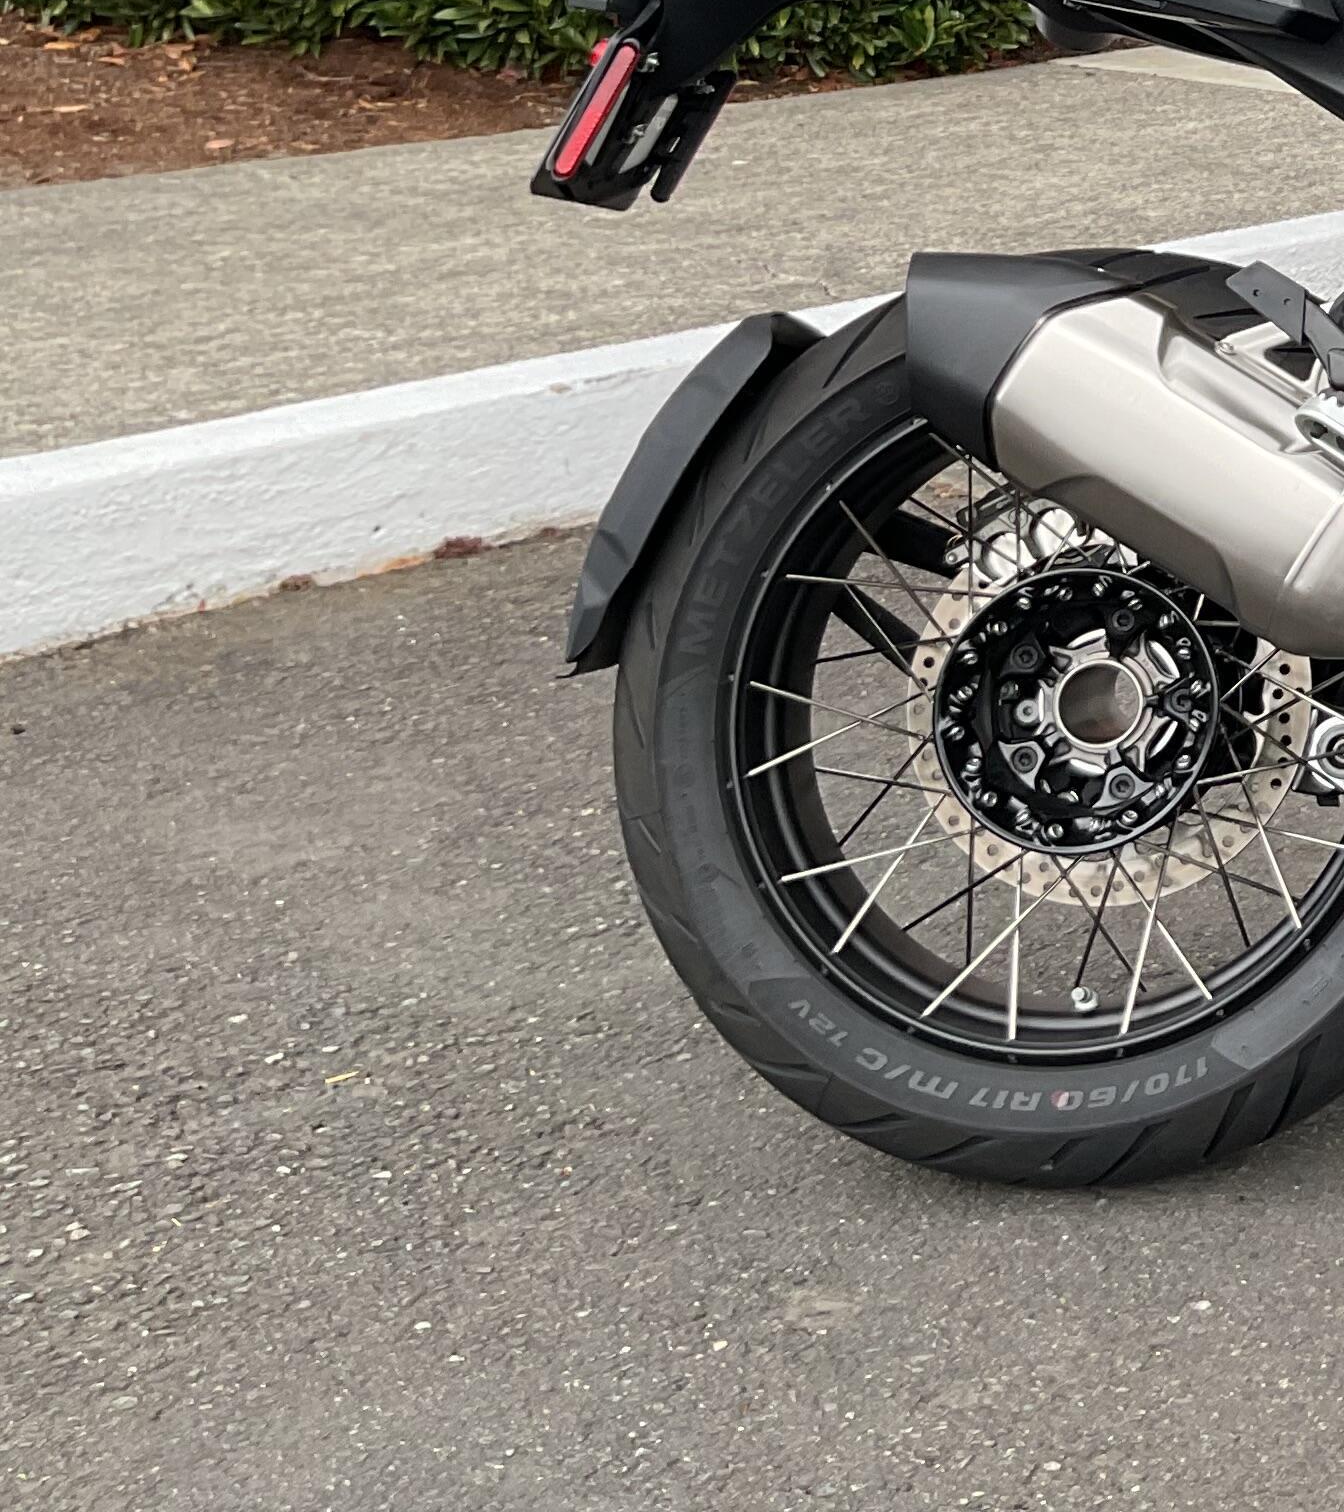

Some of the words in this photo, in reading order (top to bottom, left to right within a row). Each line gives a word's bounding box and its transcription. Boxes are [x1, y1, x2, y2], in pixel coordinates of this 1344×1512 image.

[678, 395, 869, 656] METZELER
[787, 998, 850, 1049] 72V
[967, 1086, 1042, 1113] R17
[1054, 1055, 1209, 1111] 170/60
